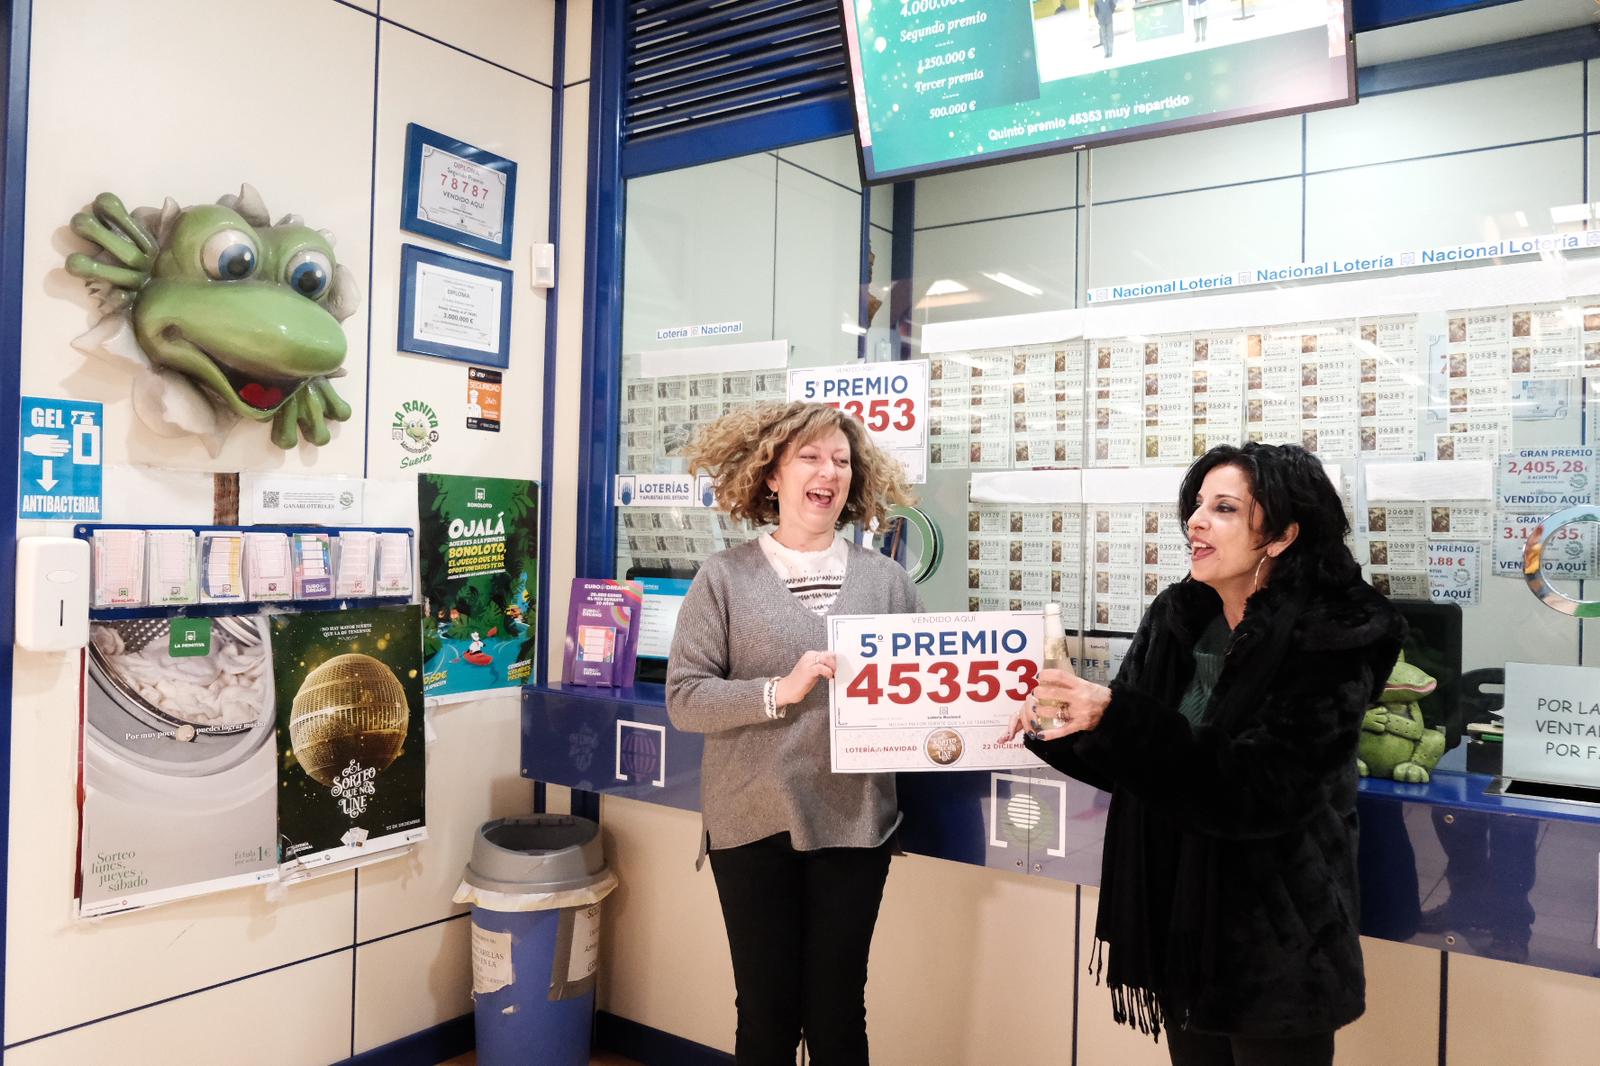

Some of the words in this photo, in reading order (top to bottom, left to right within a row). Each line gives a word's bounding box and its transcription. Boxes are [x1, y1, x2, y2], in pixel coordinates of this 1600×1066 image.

[900, 20, 945, 43] Segundo
[947, 11, 987, 35] premio
[968, 48, 976, 59] €
[914, 78, 947, 94] Tercer
[947, 70, 984, 89] premio
[929, 104, 967, 119] 500.000
[968, 100, 976, 111] €
[988, 124, 1025, 141] Quinto
[1027, 118, 1067, 134] premio
[1068, 109, 1103, 124] 45353
[1105, 106, 1130, 120] muy
[1133, 94, 1190, 115] repartido
[1112, 280, 1176, 298] Nacional
[1179, 274, 1233, 291] Lotería
[1257, 262, 1329, 282] Nacional
[1333, 255, 1394, 273] Lotería
[1422, 242, 1504, 263] Nacional
[656, 329, 688, 340] Lotería
[701, 322, 742, 335] Nacional
[823, 375, 908, 398] PREMIO
[31, 407, 65, 429] GEL
[392, 411, 405, 428] LA
[402, 400, 439, 428] RANITA
[400, 452, 432, 469] Suerte
[1520, 450, 1549, 458] GRAN
[1551, 449, 1593, 457] PREMIO
[639, 481, 690, 493] LOTERÍAS
[22, 494, 100, 513] ANTIBACTERIAL
[1503, 495, 1557, 504] VENDIDO
[1560, 493, 1592, 506] AQUÍ
[448, 511, 506, 540] OJALÁ
[448, 543, 507, 559] BONOLOTO,
[1436, 544, 1475, 553] PREMIO
[457, 557, 478, 566] JUEGO
[1457, 557, 1466, 566] €
[1556, 560, 1587, 573] AQUÍ
[1443, 588, 1472, 599] AQUÍ
[911, 616, 951, 624] VENDIDO
[859, 633, 884, 658] 5º
[891, 629, 1028, 657] PREMIO
[846, 658, 1040, 705] 45353
[1537, 698, 1573, 713] POR
[125, 732, 140, 740] Por
[140, 732, 156, 740] muy
[196, 727, 221, 735] puedes
[221, 723, 242, 733] lograr
[845, 745, 875, 754] LOTERÍA
[883, 744, 918, 753] NAVIDAD
[1545, 741, 1580, 758] POR
[342, 759, 363, 777] EL
[331, 767, 376, 797] SORTEO
[342, 787, 358, 799] QUE
[359, 780, 376, 795] NOS
[338, 795, 368, 818] UNE
[96, 849, 136, 864] Sorteo
[91, 861, 126, 875] lunes,
[98, 870, 137, 888] jueves
[108, 875, 148, 892] sábado
